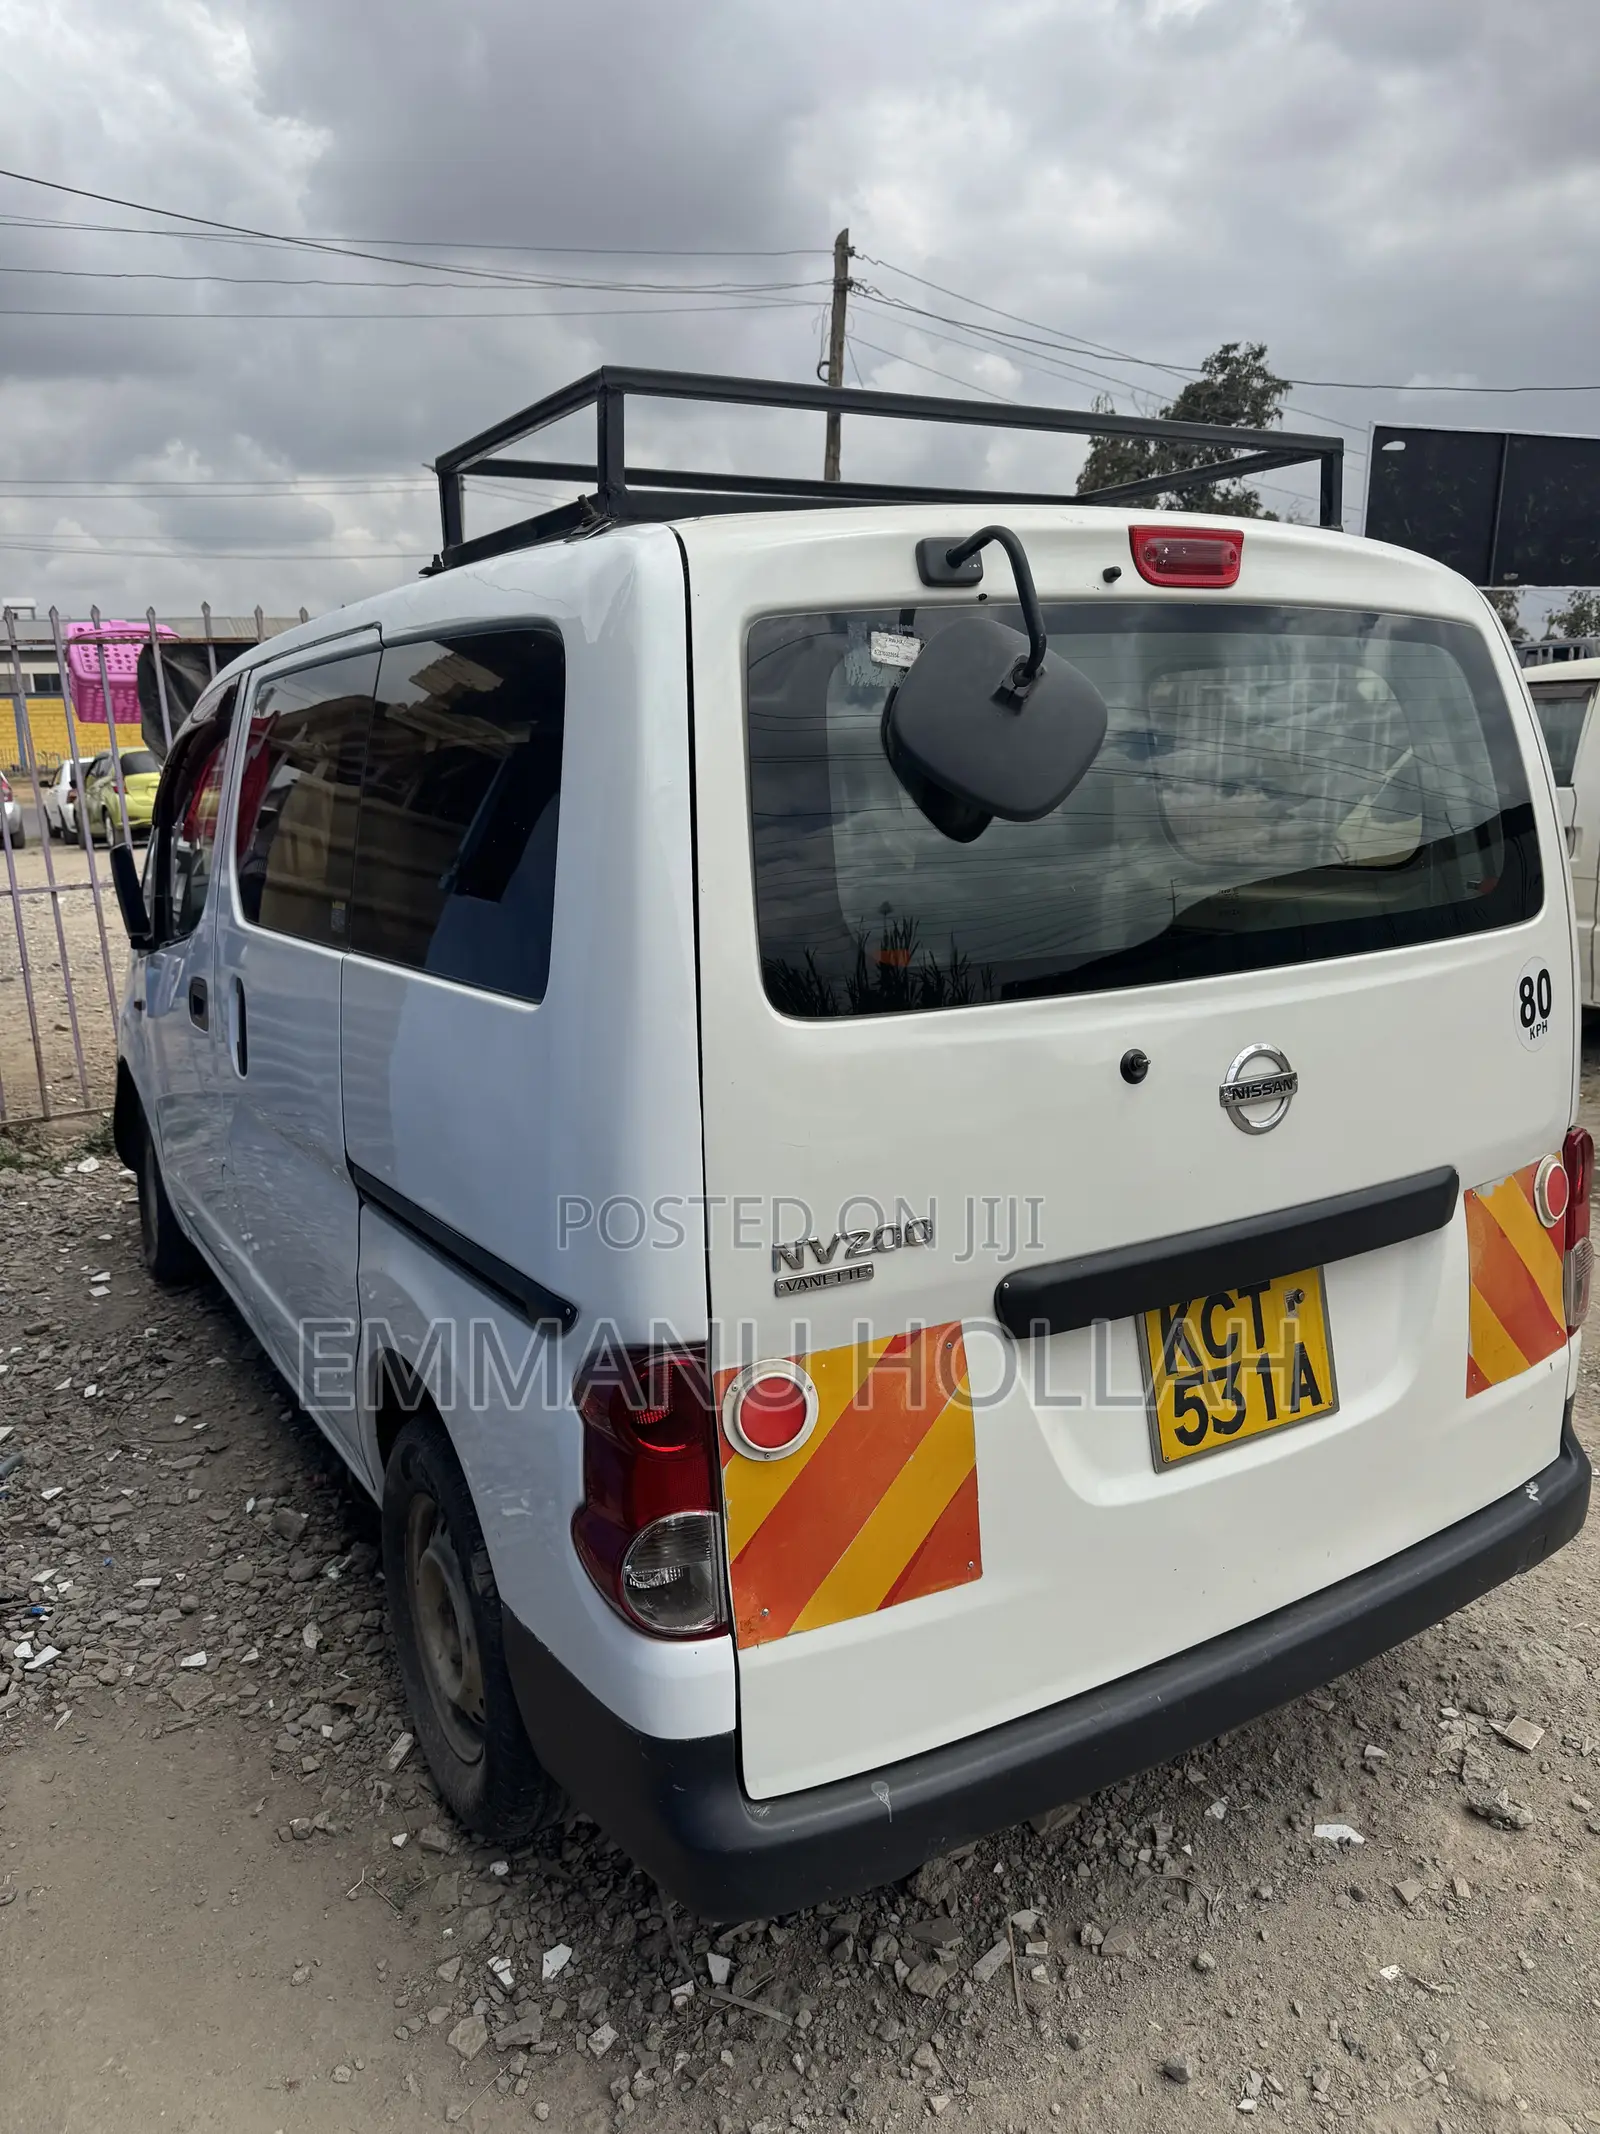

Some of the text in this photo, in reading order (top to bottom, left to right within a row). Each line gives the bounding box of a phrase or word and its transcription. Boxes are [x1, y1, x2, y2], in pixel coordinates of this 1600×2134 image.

[1519, 968, 1552, 1028] 80
[1529, 1019, 1548, 1041] KPH
[1231, 1078, 1293, 1101] NISSAN
[772, 1216, 934, 1273] NV200
[785, 1267, 869, 1292] VANETTE
[1160, 1280, 1271, 1376] KCT
[1173, 1341, 1325, 1447] 531A
